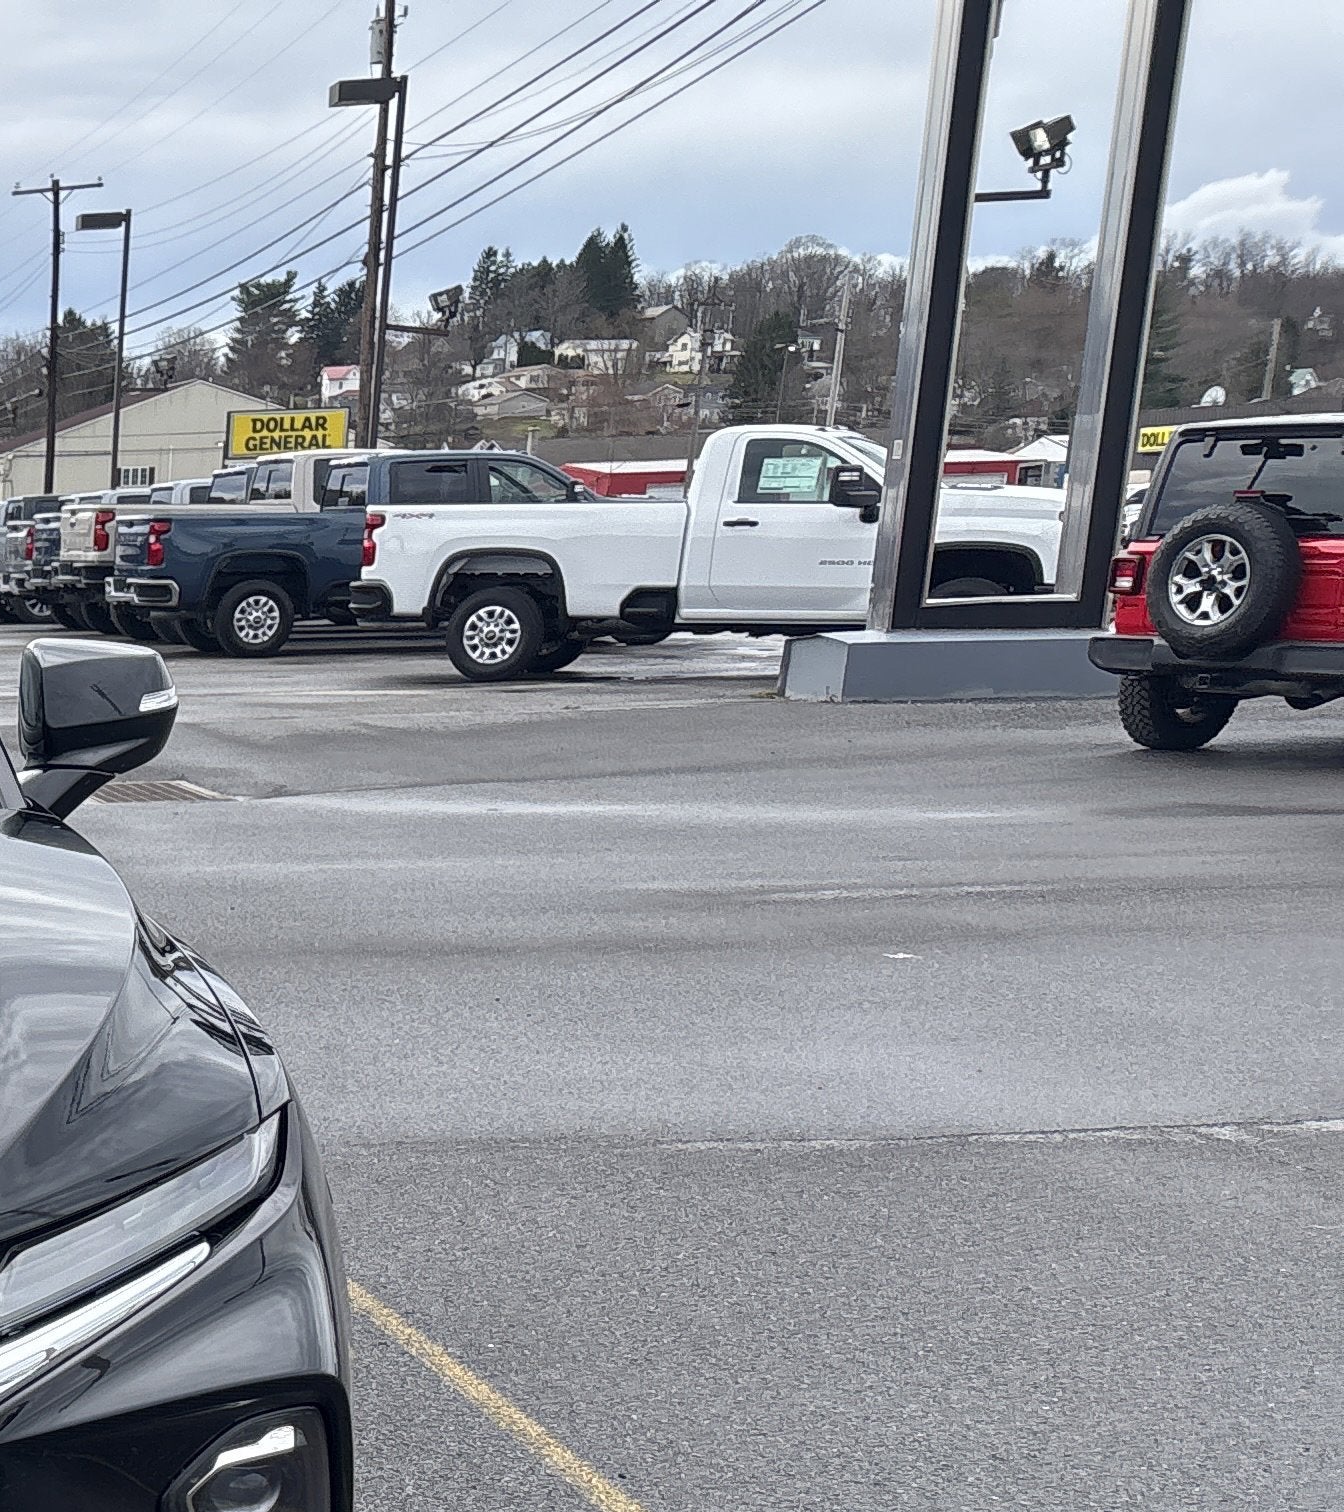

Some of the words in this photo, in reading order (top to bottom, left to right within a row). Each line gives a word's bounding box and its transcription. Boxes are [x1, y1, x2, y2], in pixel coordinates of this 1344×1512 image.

[251, 415, 329, 433] DOLLAR
[244, 433, 331, 451] GENERAL
[1141, 431, 1173, 447] DOLL
